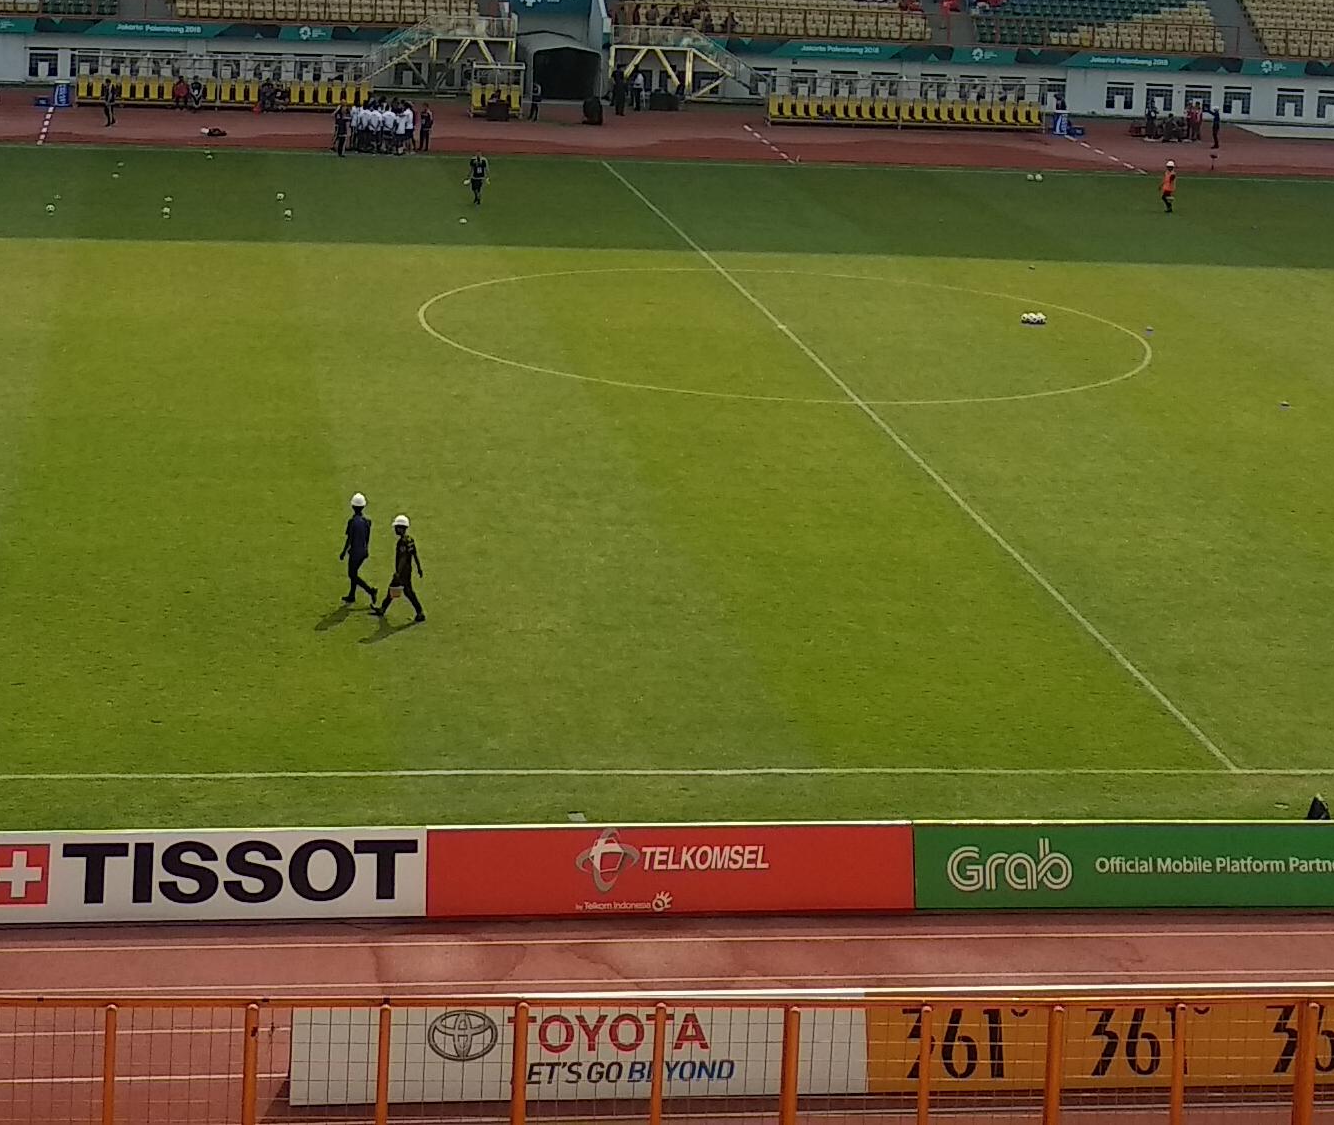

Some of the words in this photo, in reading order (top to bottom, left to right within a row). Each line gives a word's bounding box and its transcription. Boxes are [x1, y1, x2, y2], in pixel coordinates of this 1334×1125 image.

[641, 845, 770, 871] TELKOMSEL
[947, 837, 1073, 892] Grab
[1095, 856, 1153, 874] Official
[1157, 856, 1212, 873] Mobile
[1216, 856, 1285, 874] Platform
[63, 838, 419, 905] TISSOT
[584, 901, 612, 910] Telkom
[613, 901, 651, 910] Indonesia
[510, 1061, 583, 1085] ET'S
[587, 1061, 624, 1084] GO
